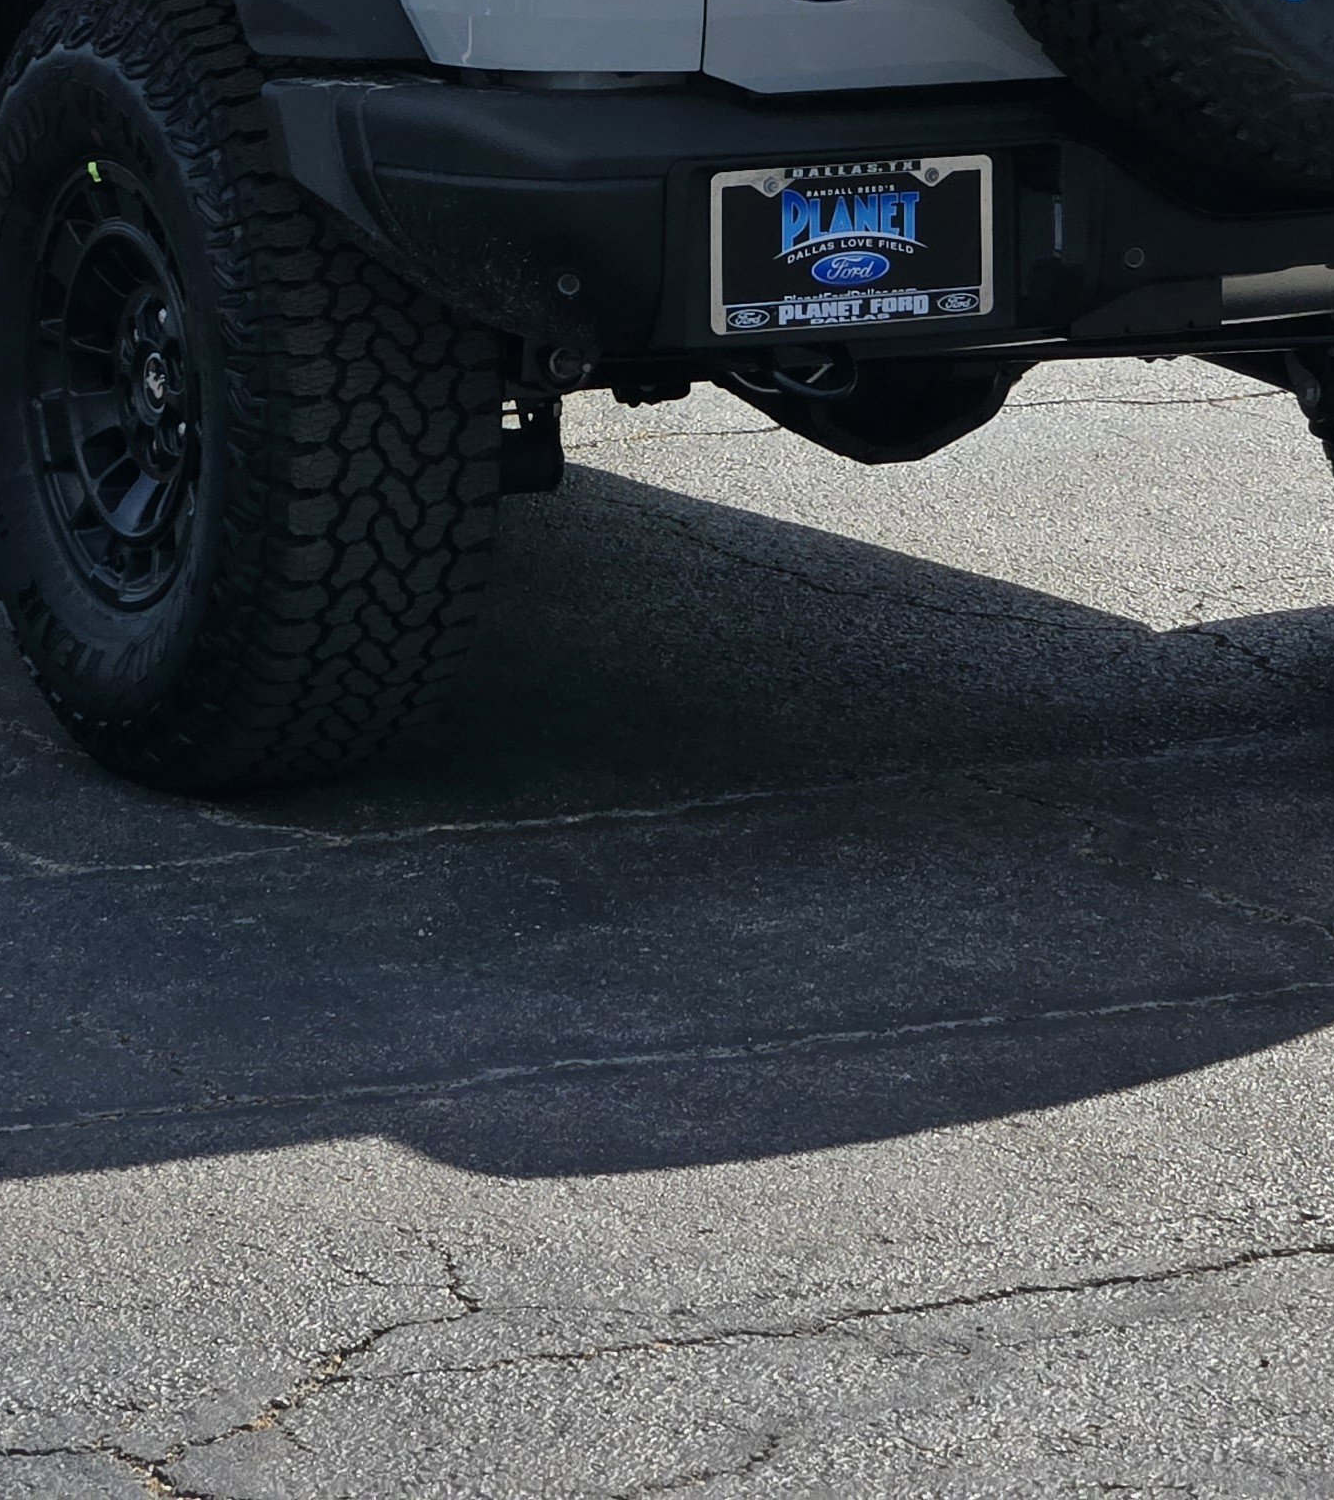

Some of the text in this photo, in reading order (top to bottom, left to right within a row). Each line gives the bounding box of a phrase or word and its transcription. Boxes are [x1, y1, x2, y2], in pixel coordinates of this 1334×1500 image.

[806, 184, 895, 198] RANDALL REED'S
[781, 190, 920, 253] PLANET
[787, 238, 914, 264] DALLAS LOVE FIELD
[827, 257, 875, 280] Ford
[778, 294, 929, 326] PLANET FORD
[810, 312, 891, 326] DALLAS
